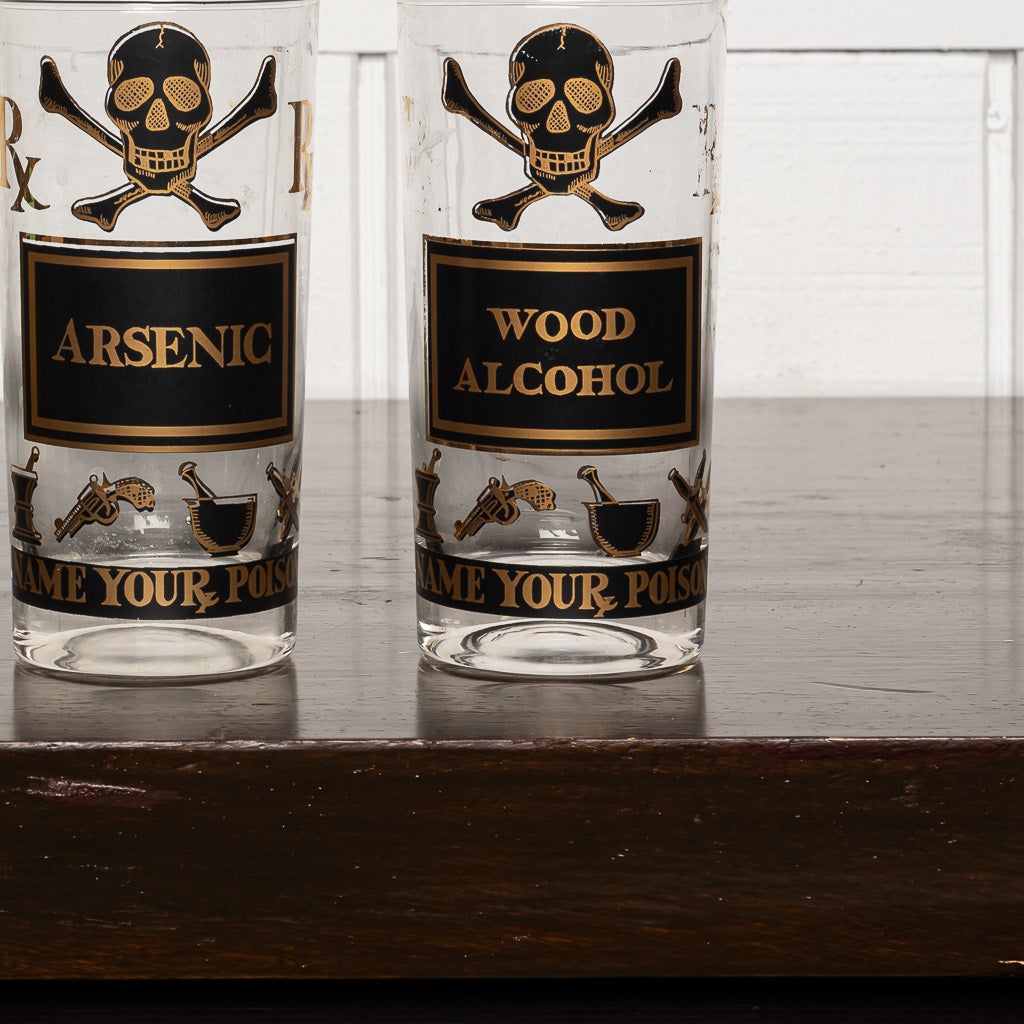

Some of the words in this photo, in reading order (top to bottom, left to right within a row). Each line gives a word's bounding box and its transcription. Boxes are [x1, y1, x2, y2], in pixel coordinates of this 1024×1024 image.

[51, 318, 272, 368] ARSENIC
[486, 308, 636, 342] WOOD
[453, 357, 673, 396] ALCOHOL
